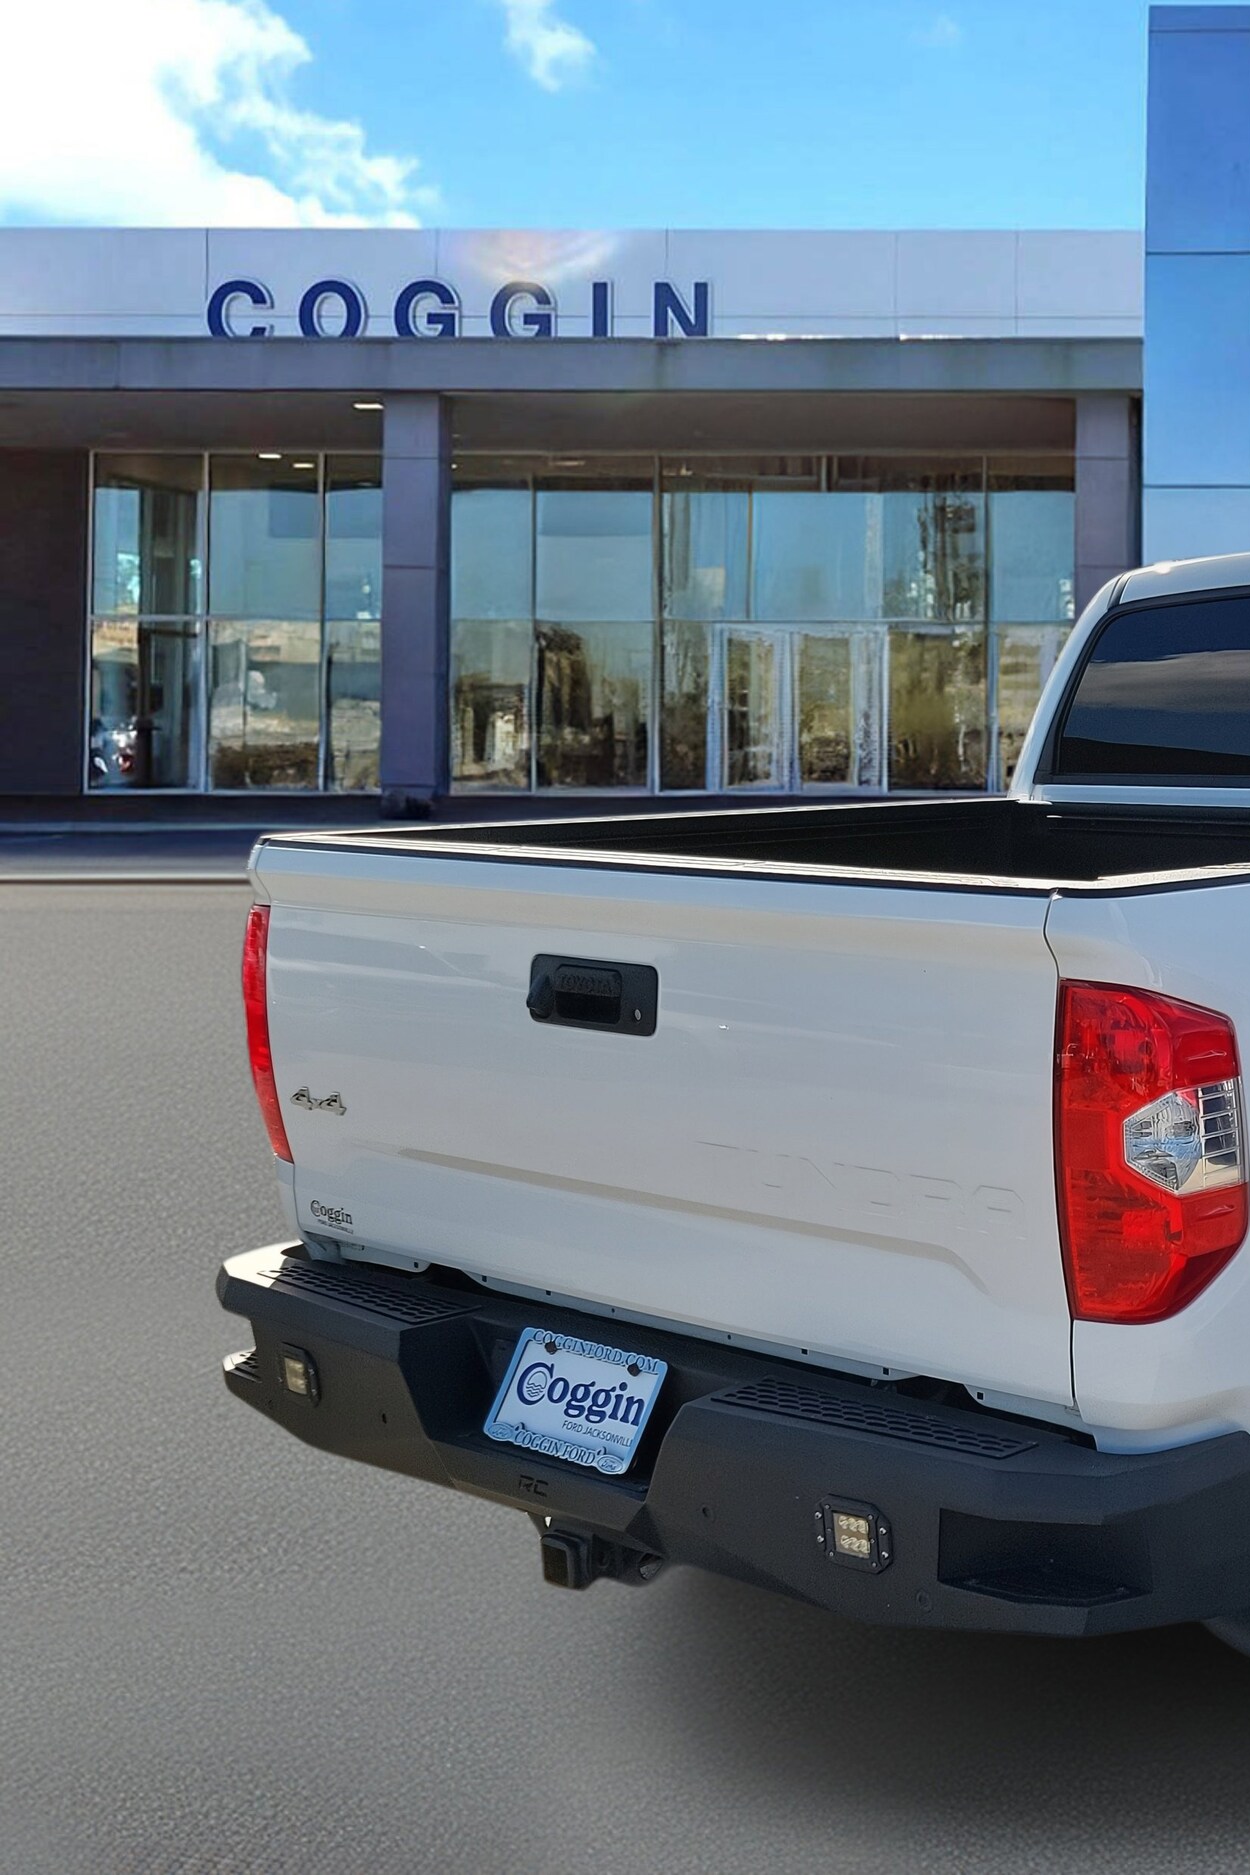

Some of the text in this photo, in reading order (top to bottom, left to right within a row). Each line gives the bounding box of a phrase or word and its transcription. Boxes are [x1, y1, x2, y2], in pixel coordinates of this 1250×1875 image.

[206, 279, 709, 338] COGGIN
[310, 1200, 353, 1225] Coggin
[532, 1329, 659, 1373] COGGINFORD.COM
[516, 1361, 645, 1427] Coggin
[562, 1420, 583, 1433] FORD
[514, 1430, 596, 1465] COGGIN FORD
